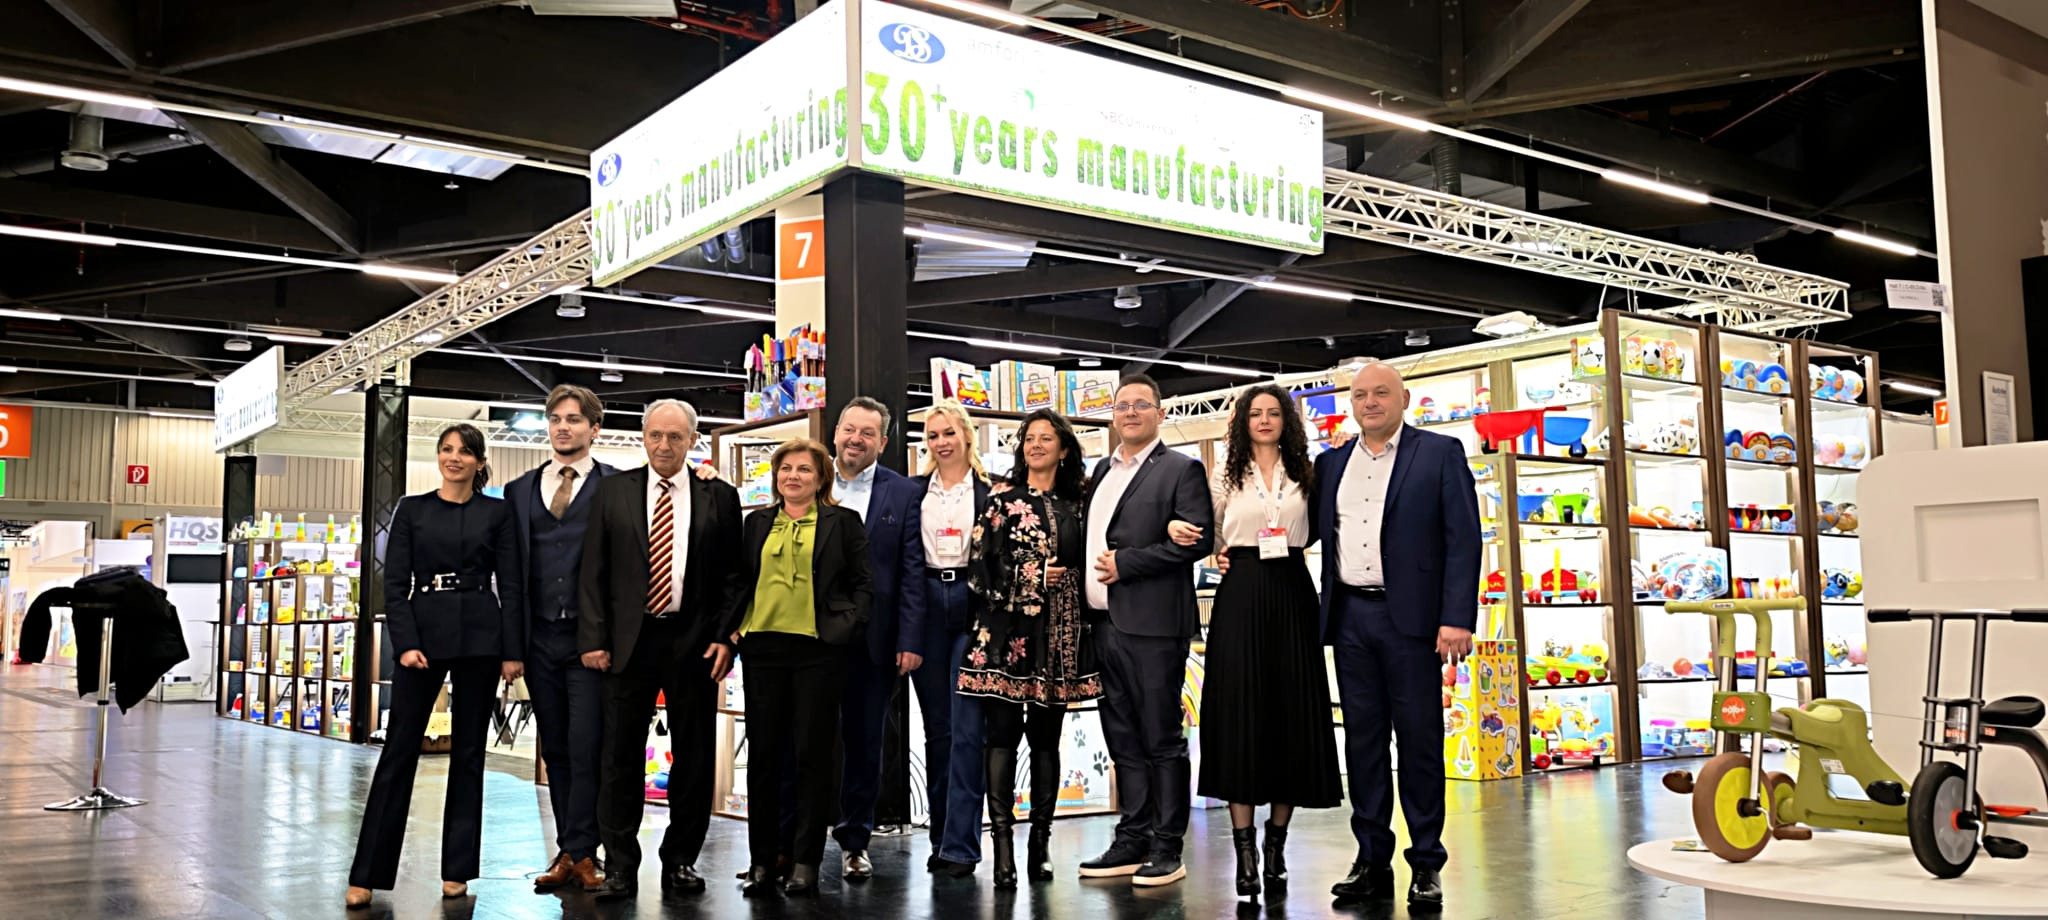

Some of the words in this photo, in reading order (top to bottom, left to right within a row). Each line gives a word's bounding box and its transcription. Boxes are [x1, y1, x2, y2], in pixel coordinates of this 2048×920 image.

[623, 183, 672, 260] years
[680, 86, 849, 220] manufacturing
[948, 107, 1059, 176] years
[1077, 134, 1323, 243] manufacturing
[793, 231, 814, 269] 7
[1939, 404, 1947, 422] 7
[169, 521, 219, 542] HQS
